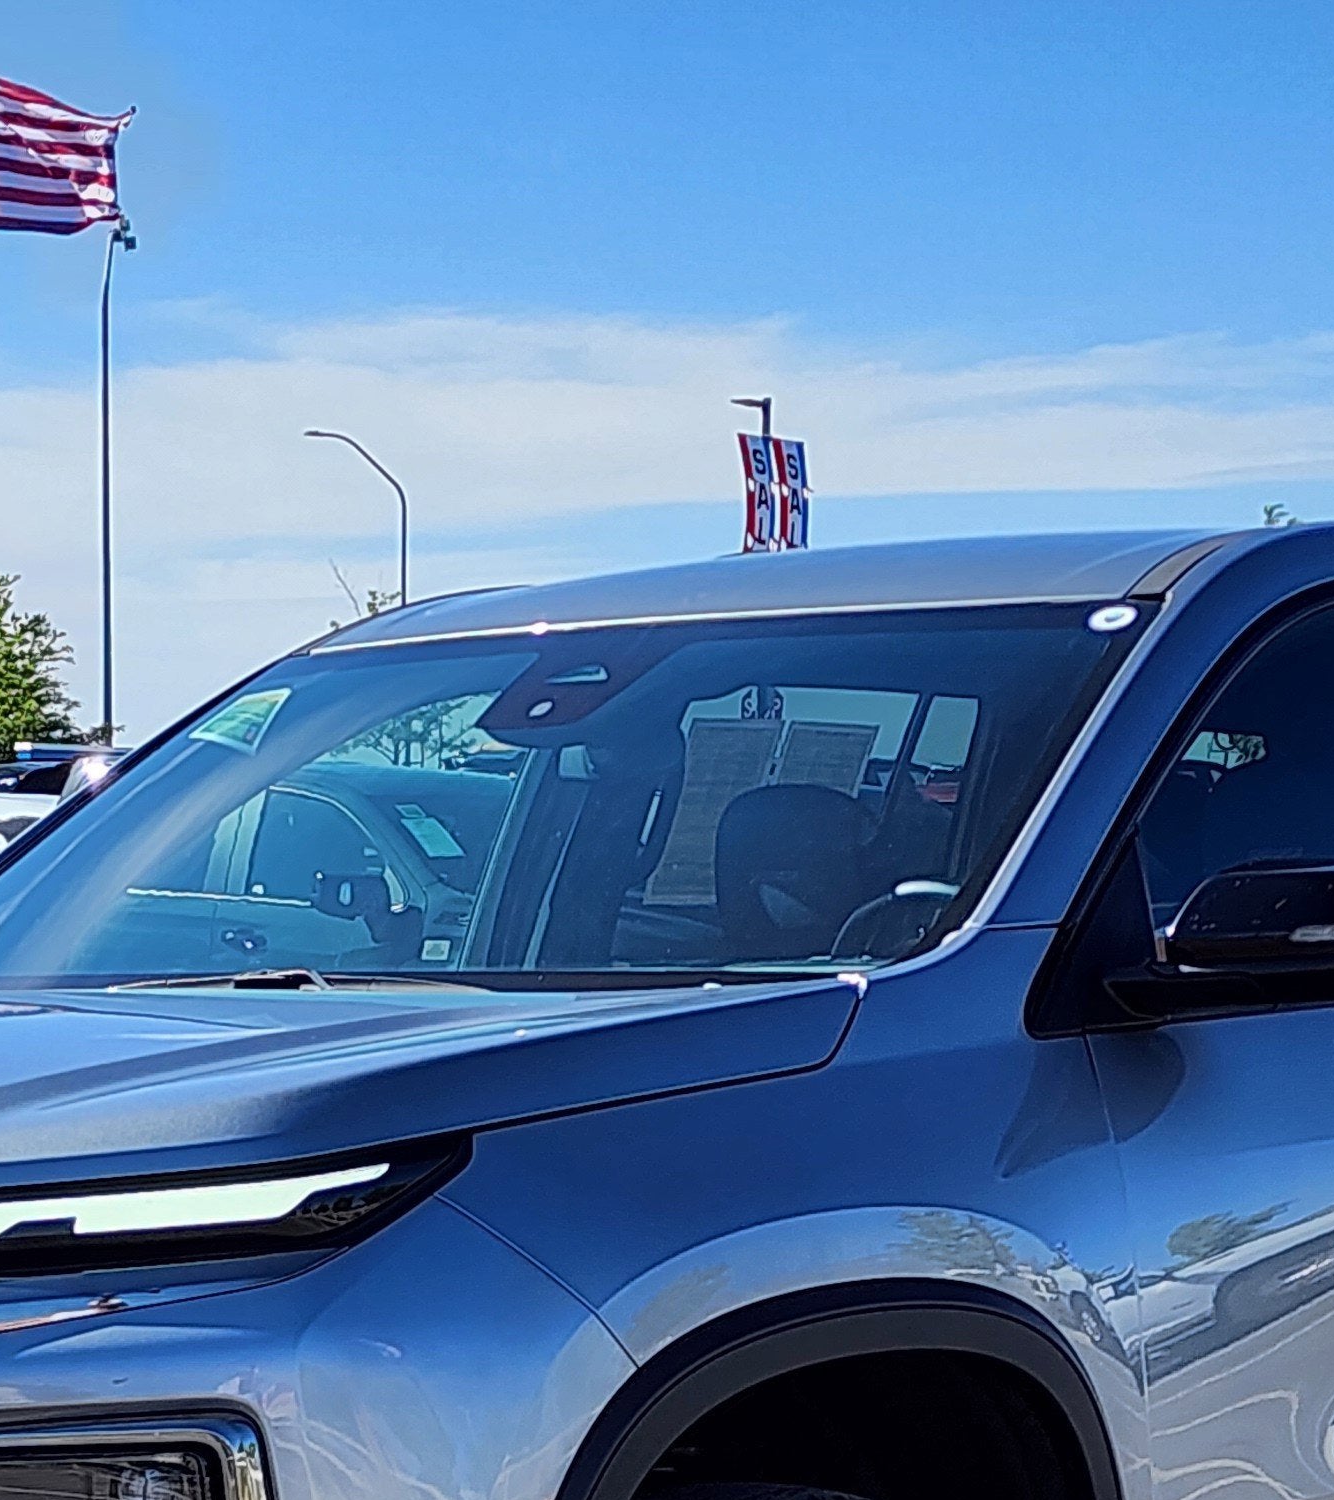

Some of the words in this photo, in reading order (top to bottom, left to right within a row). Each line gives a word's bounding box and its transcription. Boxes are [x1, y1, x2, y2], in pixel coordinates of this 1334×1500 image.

[752, 448, 769, 545] SAL
[786, 453, 801, 548] SAL
[744, 697, 781, 719] SP
